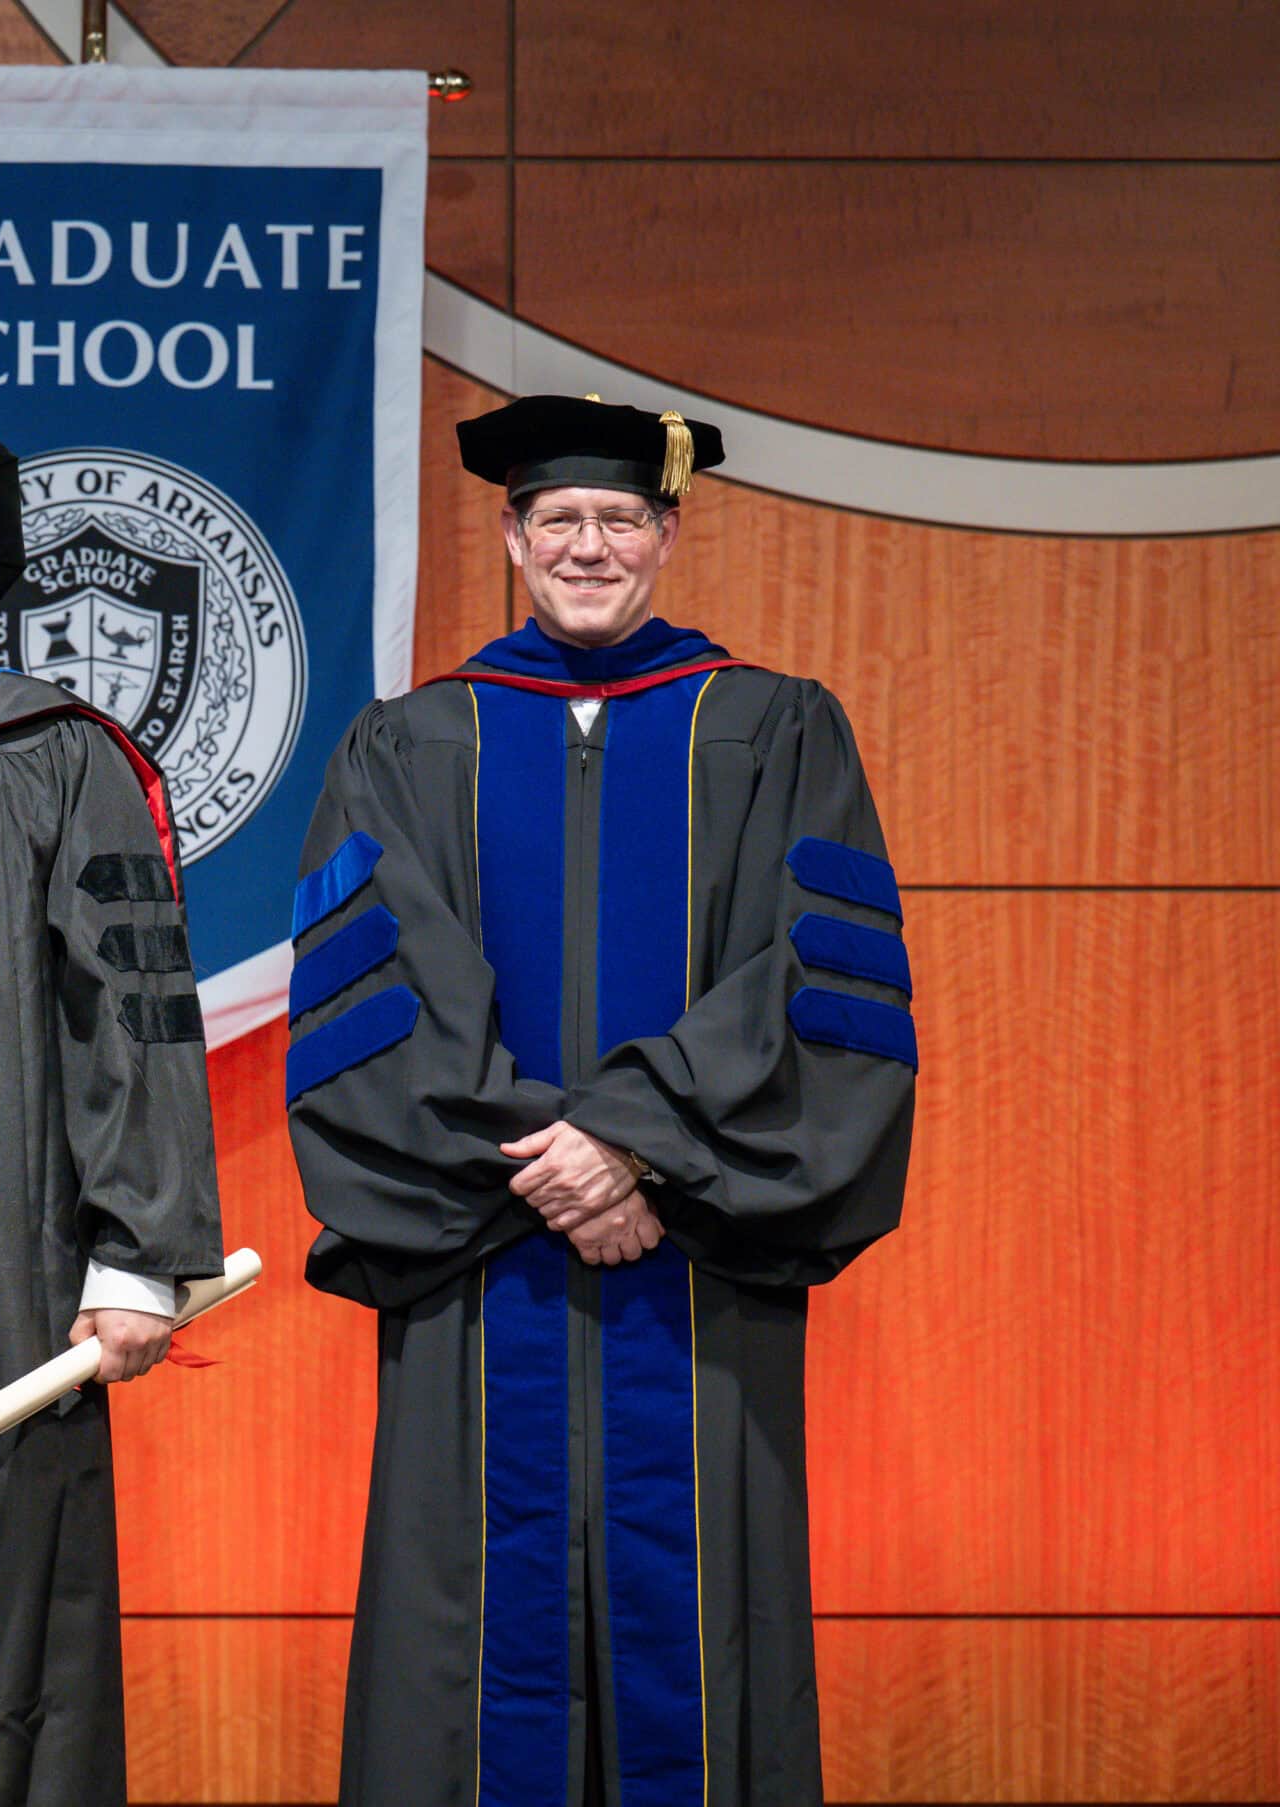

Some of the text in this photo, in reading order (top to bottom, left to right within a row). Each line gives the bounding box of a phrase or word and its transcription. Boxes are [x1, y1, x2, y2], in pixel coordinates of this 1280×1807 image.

[23, 547, 157, 586] GRADUATE
[40, 566, 138, 597] SCHOOL
[76, 468, 127, 495] OF
[137, 480, 284, 648] ARKANSAS
[137, 614, 189, 747] TO SEARCH
